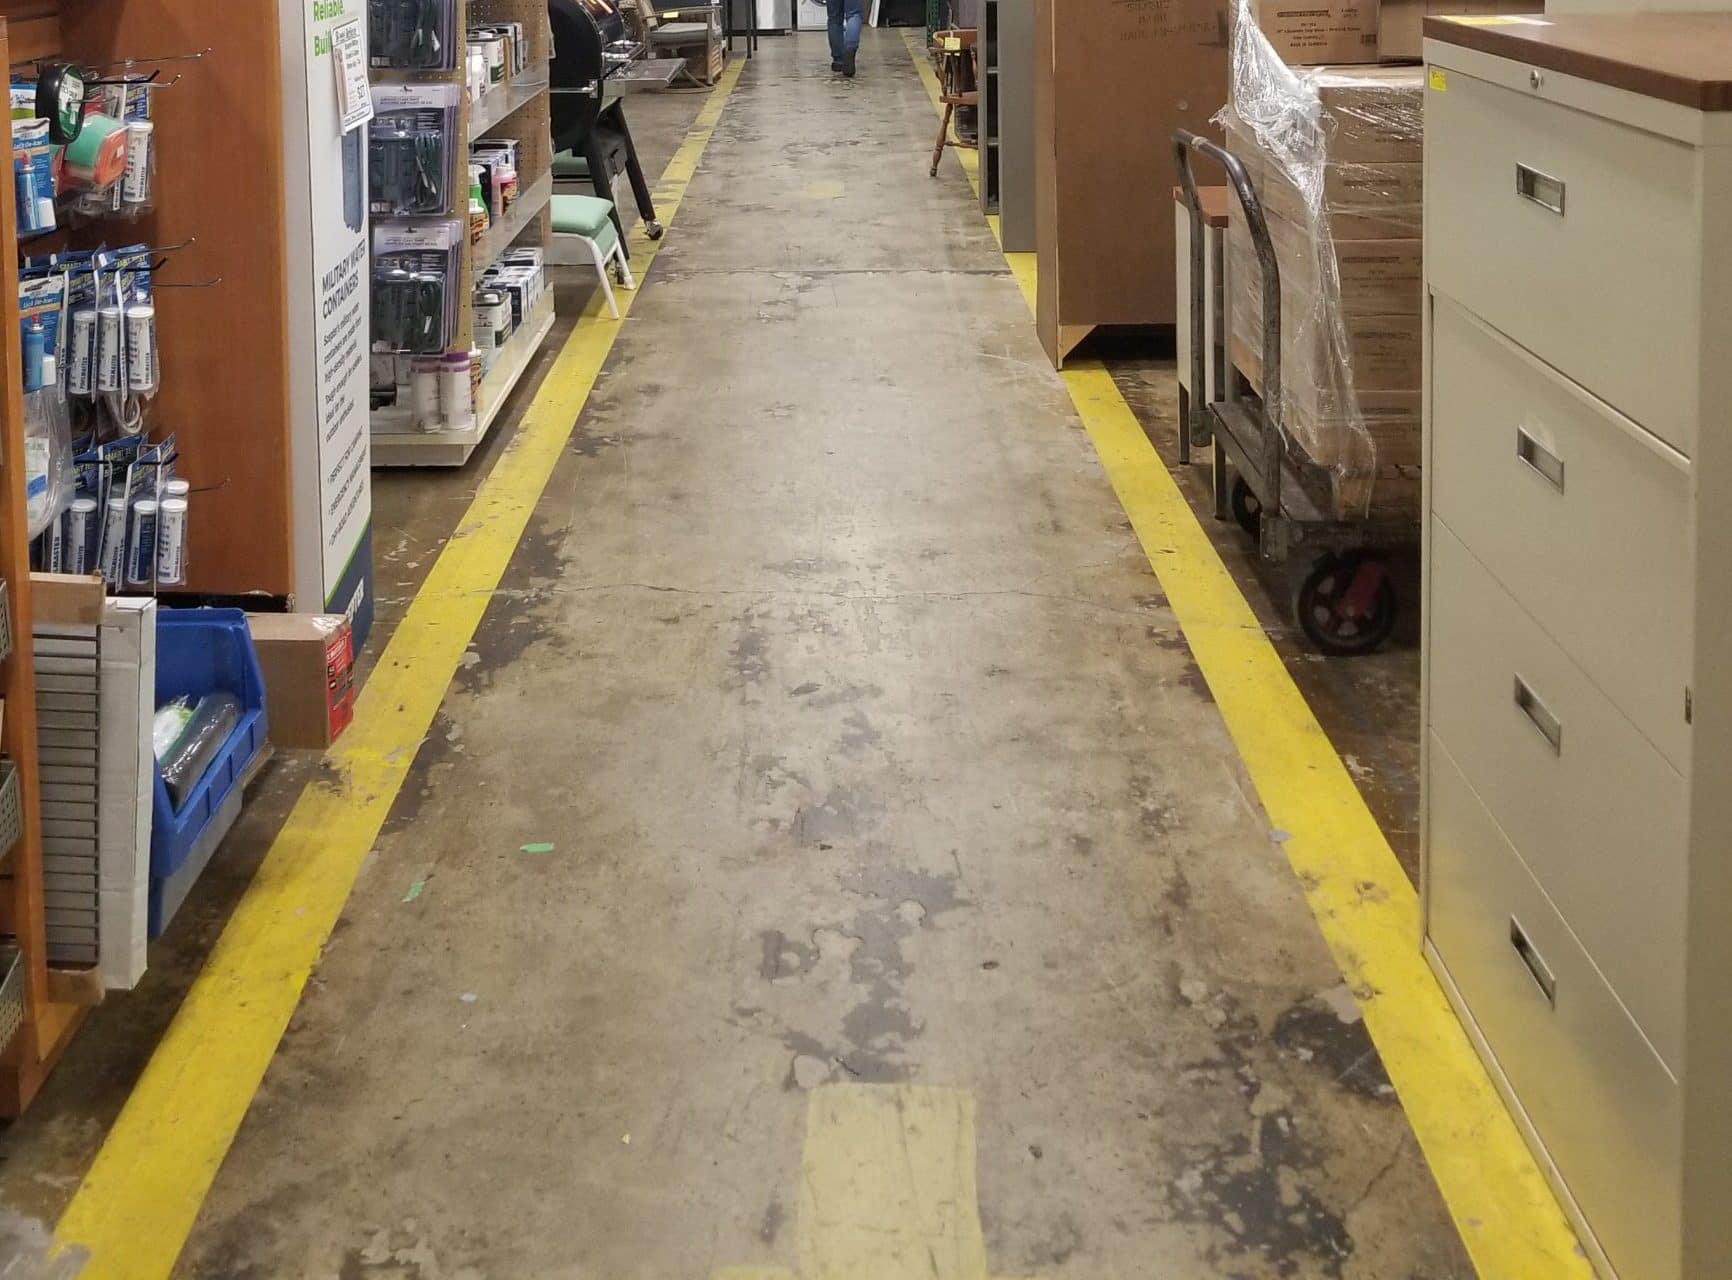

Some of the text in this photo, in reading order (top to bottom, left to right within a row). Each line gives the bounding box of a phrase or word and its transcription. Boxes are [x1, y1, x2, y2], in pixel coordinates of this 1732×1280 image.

[314, 29, 332, 57] Buil
[322, 256, 350, 296] MILITARY
[323, 270, 359, 320] CONTAINERS
